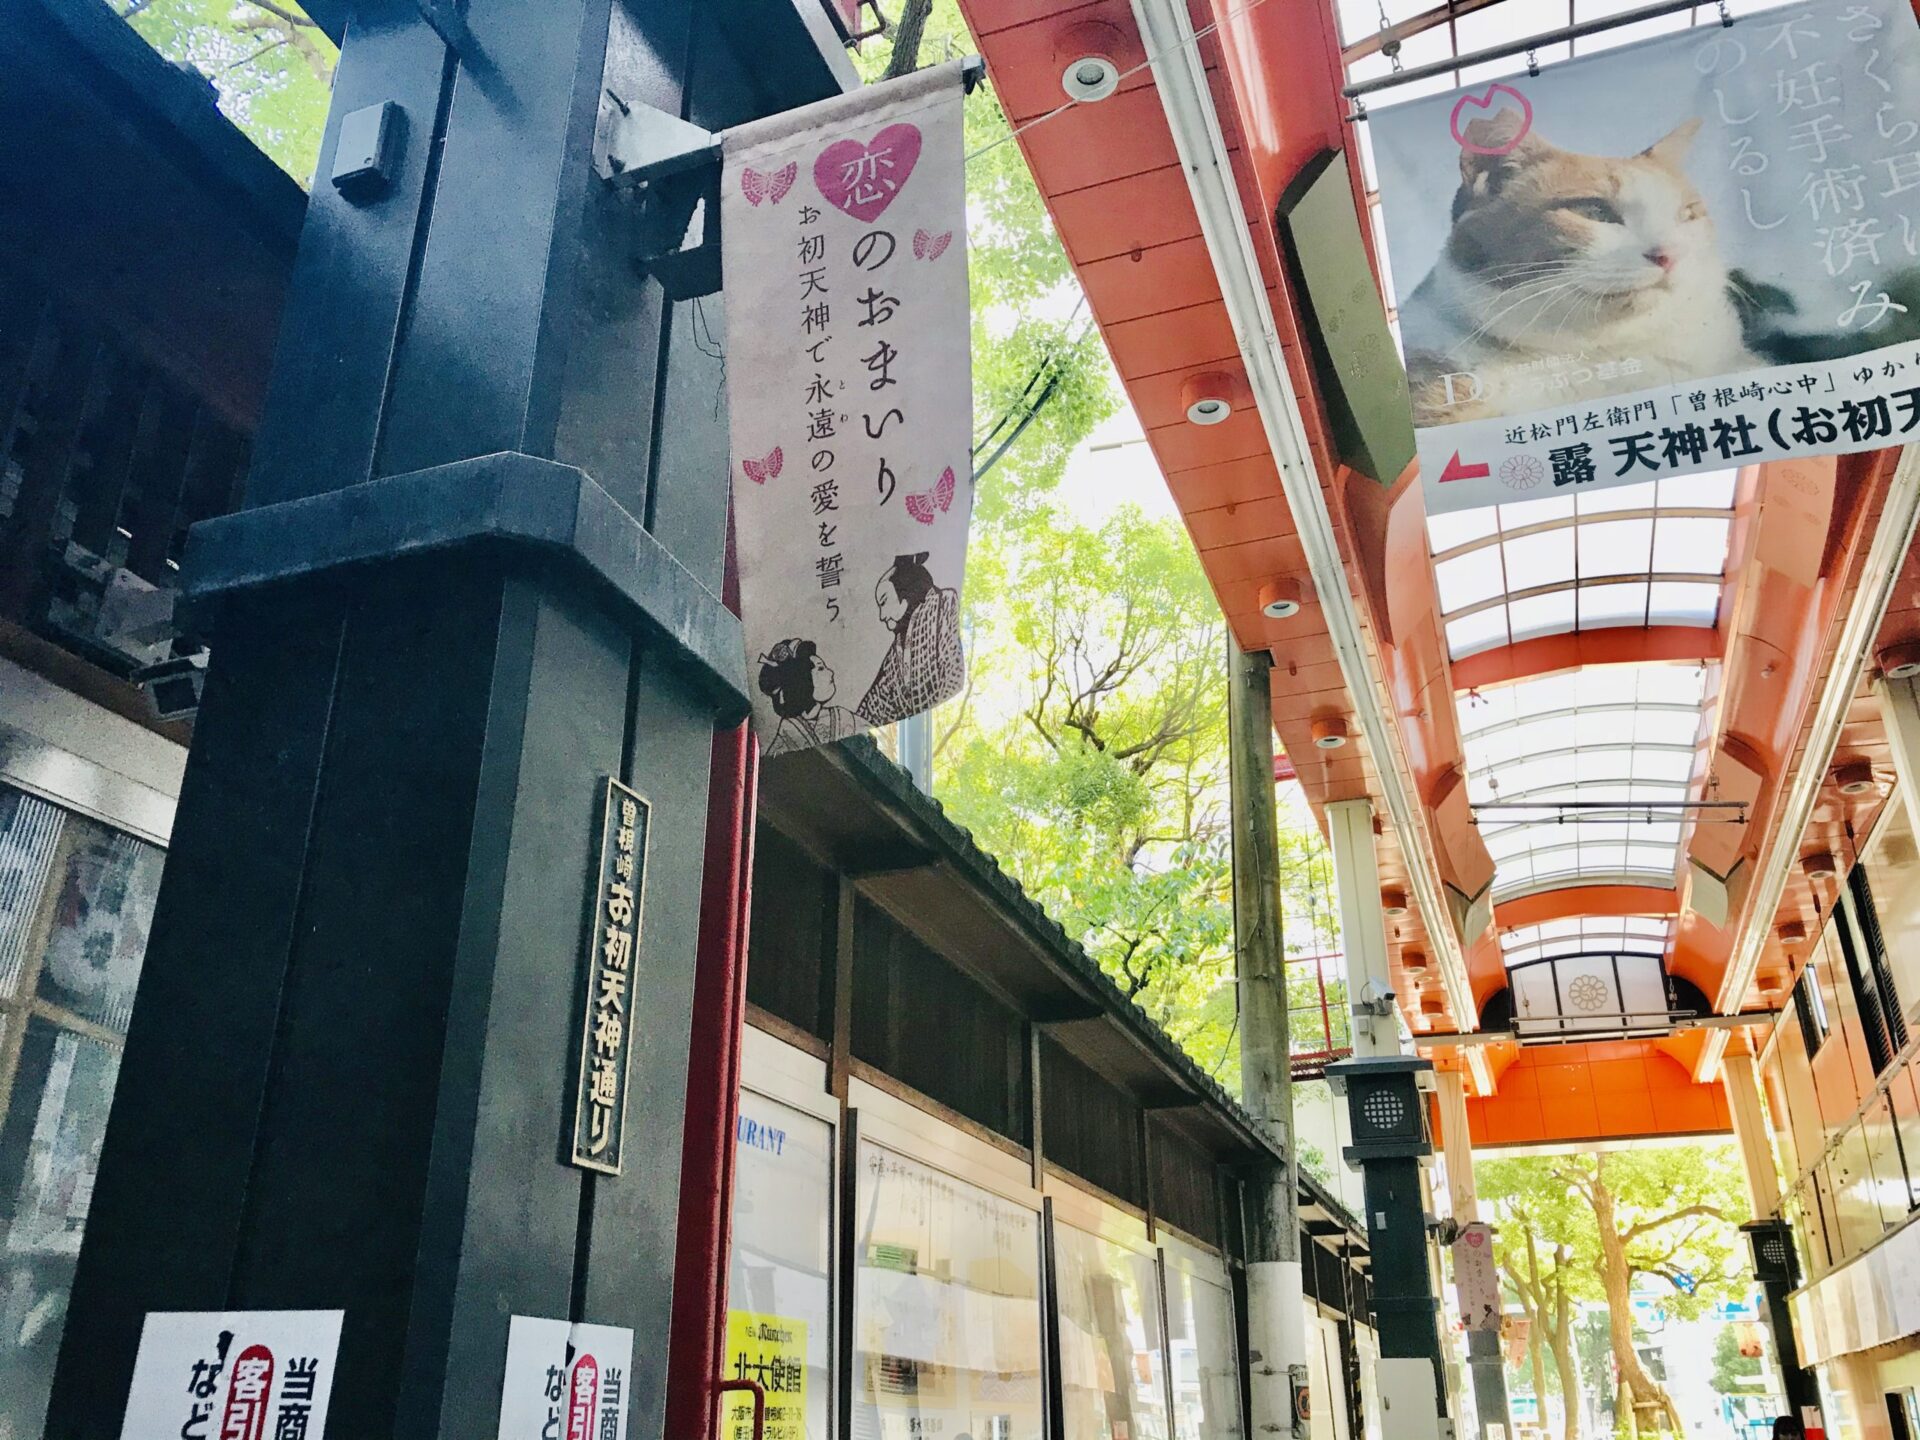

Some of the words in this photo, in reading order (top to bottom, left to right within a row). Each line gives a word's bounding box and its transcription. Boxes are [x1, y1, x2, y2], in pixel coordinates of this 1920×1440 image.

[1695, 38, 1789, 230] のしるし
[1755, 13, 1908, 330] 不妊手術済み
[796, 205, 845, 622] お初天神で永遠の愛を誓う
[840, 148, 905, 506] 恋のおまいり
